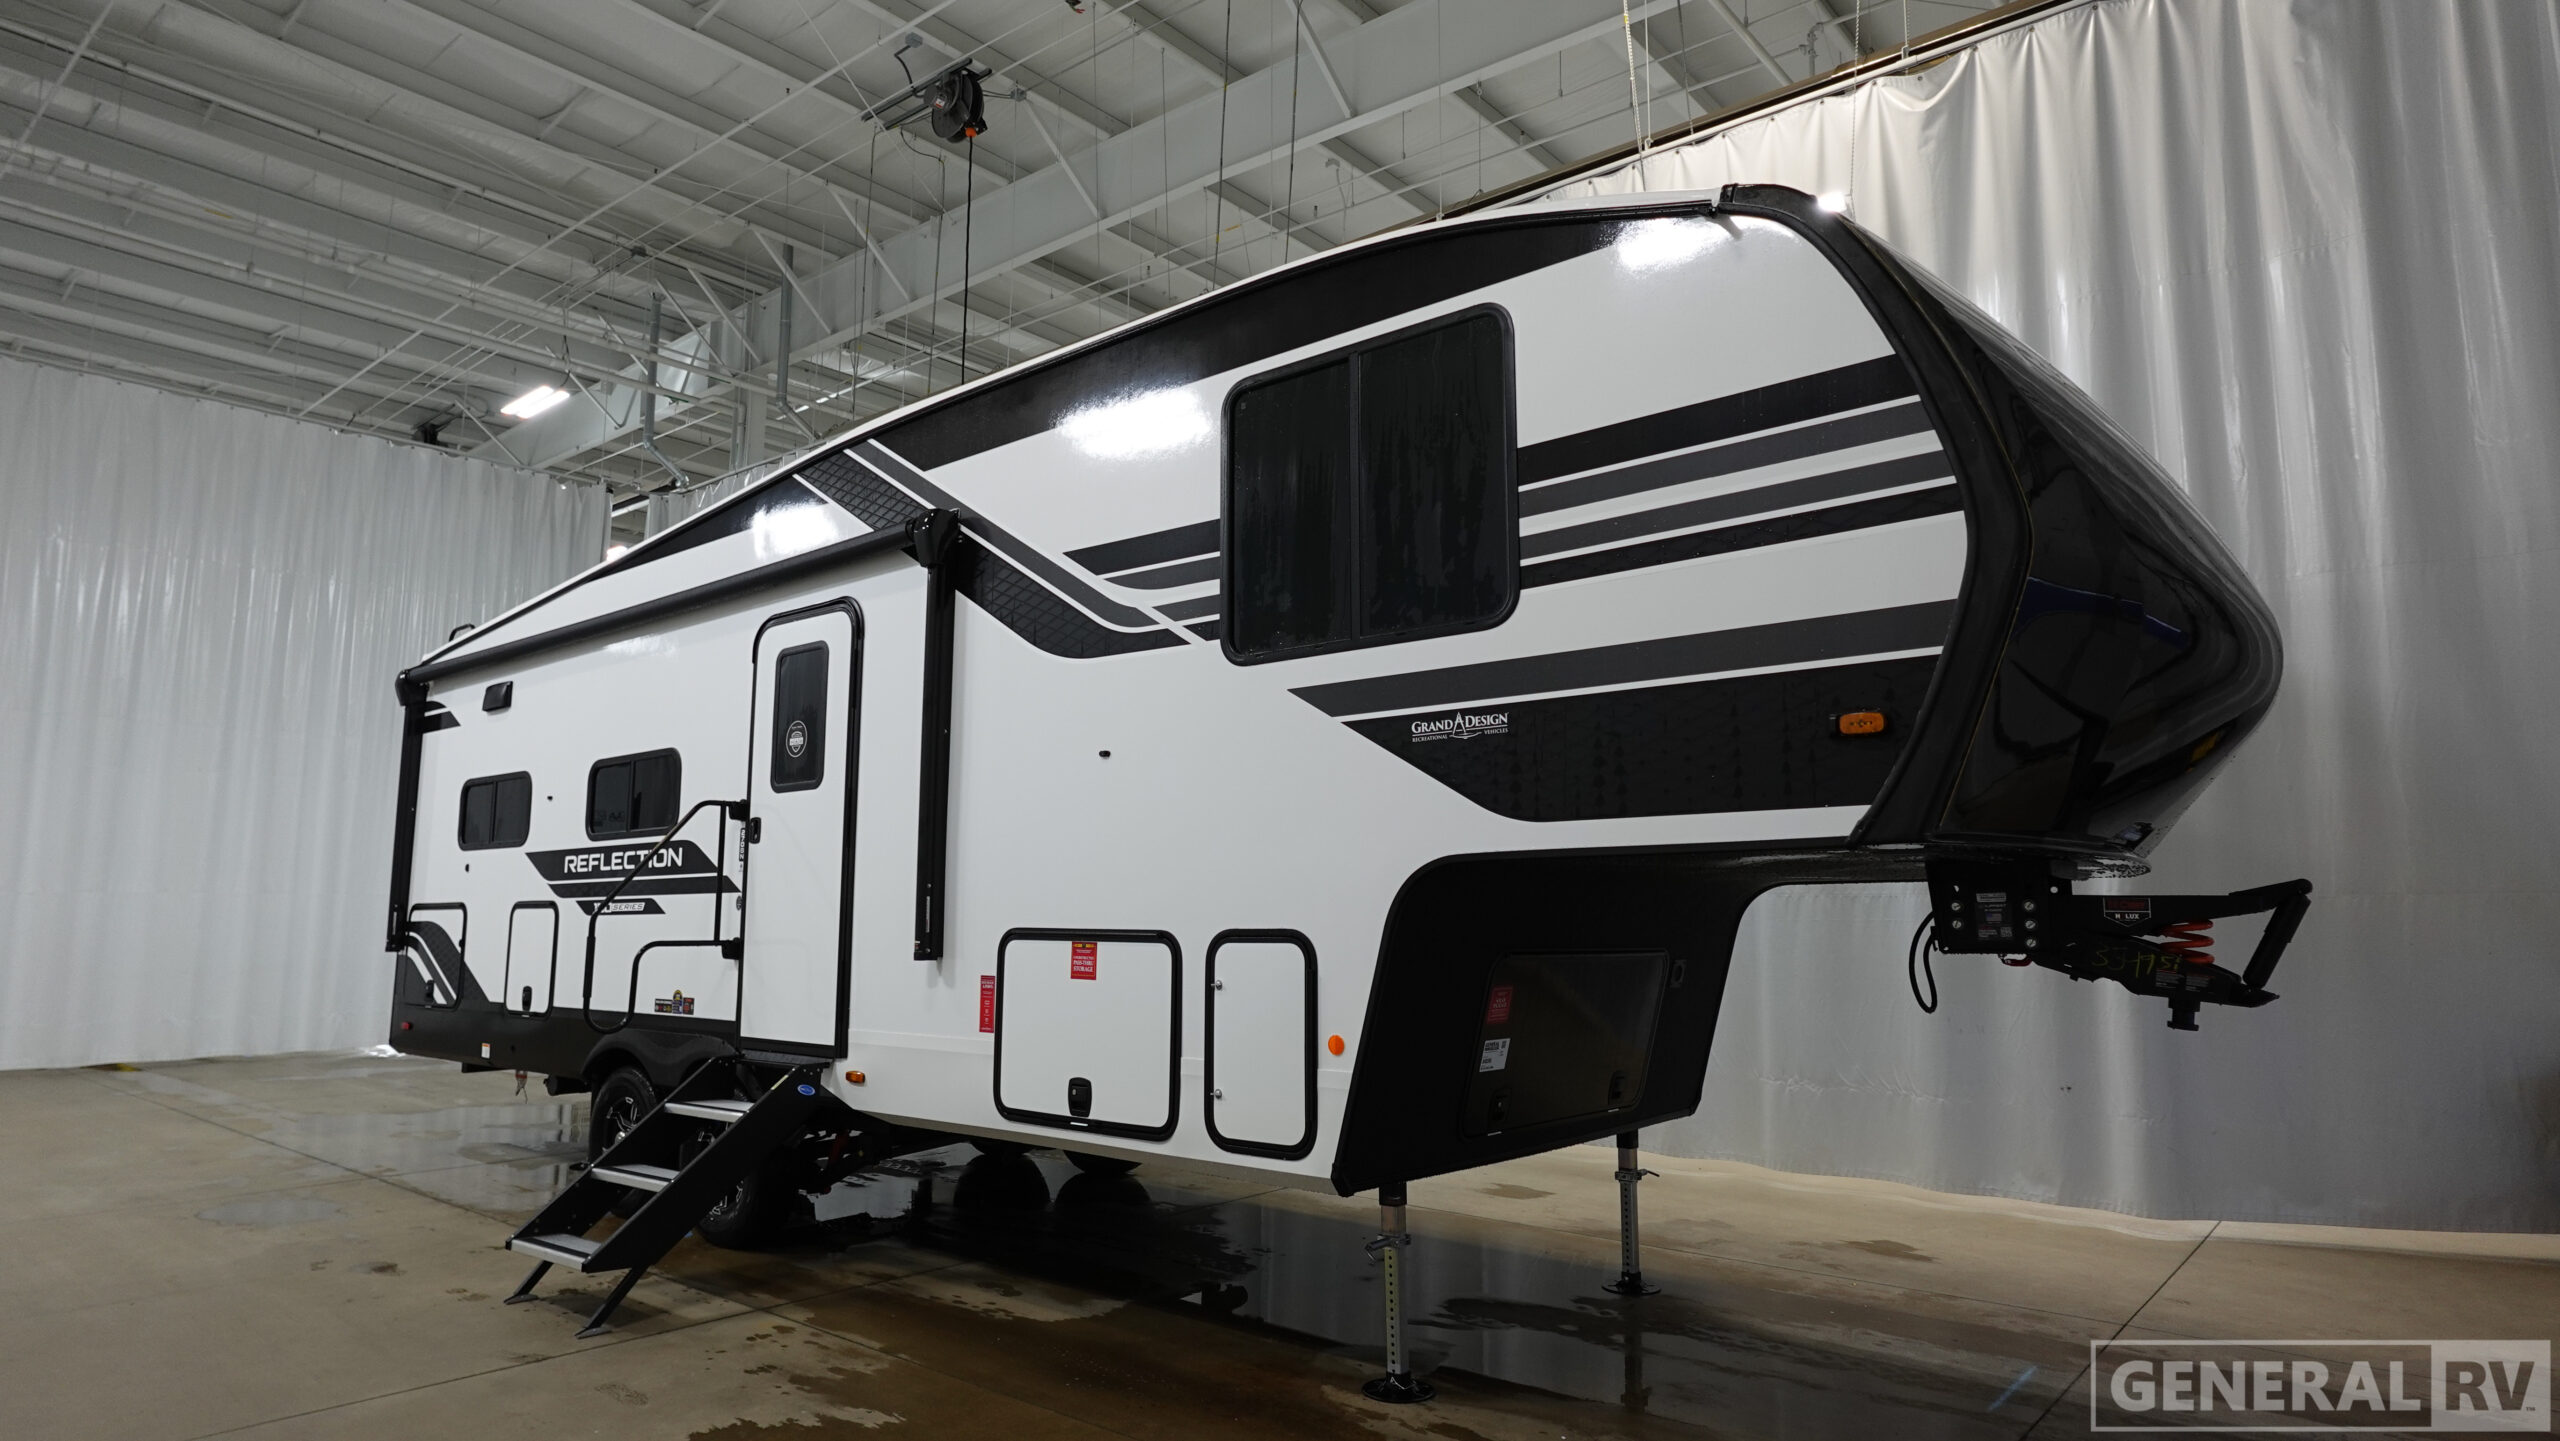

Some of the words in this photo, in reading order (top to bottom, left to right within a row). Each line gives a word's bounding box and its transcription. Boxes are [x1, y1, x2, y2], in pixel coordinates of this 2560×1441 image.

[1411, 719, 1453, 734] GRAND
[1465, 713, 1508, 728] DESIGN
[1412, 735, 1448, 743] RECREATIONAL
[564, 847, 683, 873] REFLECTION
[612, 903, 643, 911] SERIES
